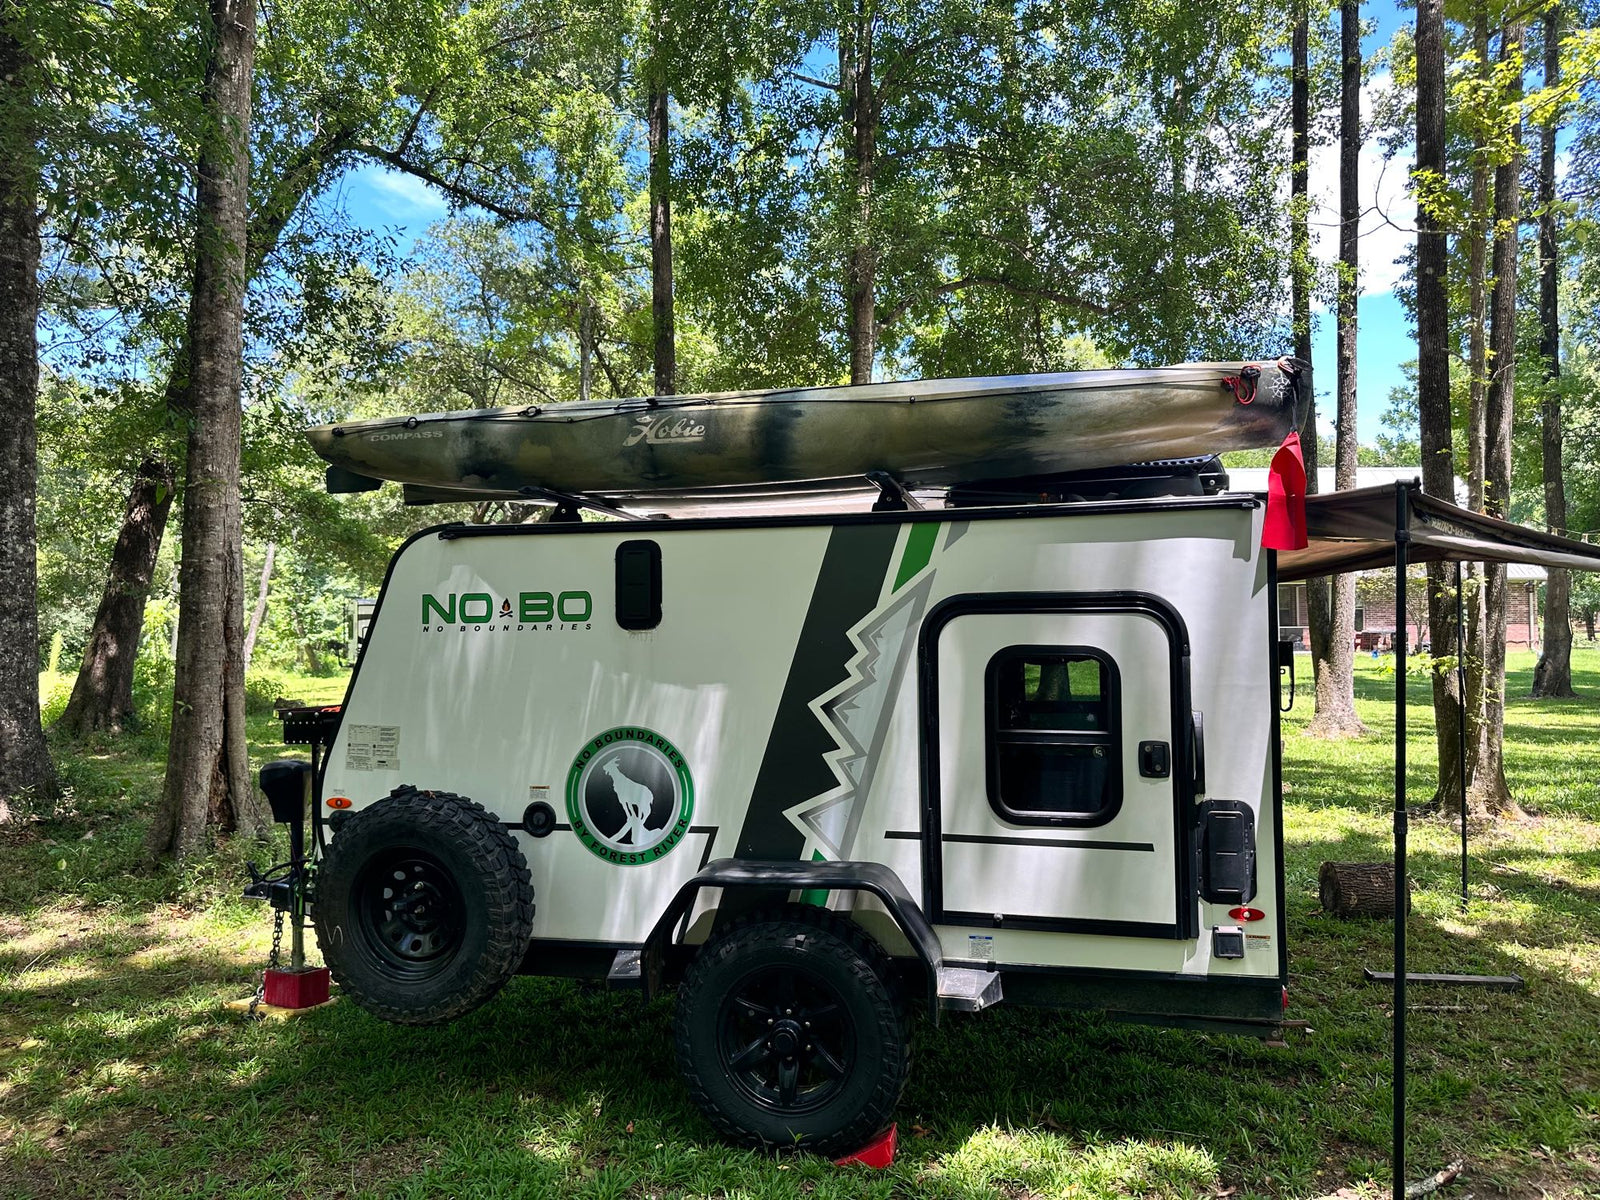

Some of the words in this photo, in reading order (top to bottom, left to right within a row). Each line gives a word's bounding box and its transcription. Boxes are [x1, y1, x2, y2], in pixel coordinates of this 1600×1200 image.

[370, 430, 444, 442] COMPASS
[622, 415, 706, 446] Hobie
[422, 593, 493, 624] NO
[519, 591, 592, 622] BO
[422, 625, 444, 633] NO
[459, 623, 592, 632] BOUNDARIES
[575, 750, 591, 770] NO
[594, 730, 684, 769] BOUNDARIES
[574, 820, 589, 837] BY
[590, 841, 647, 863] FOREST
[652, 818, 688, 857] RIVER
